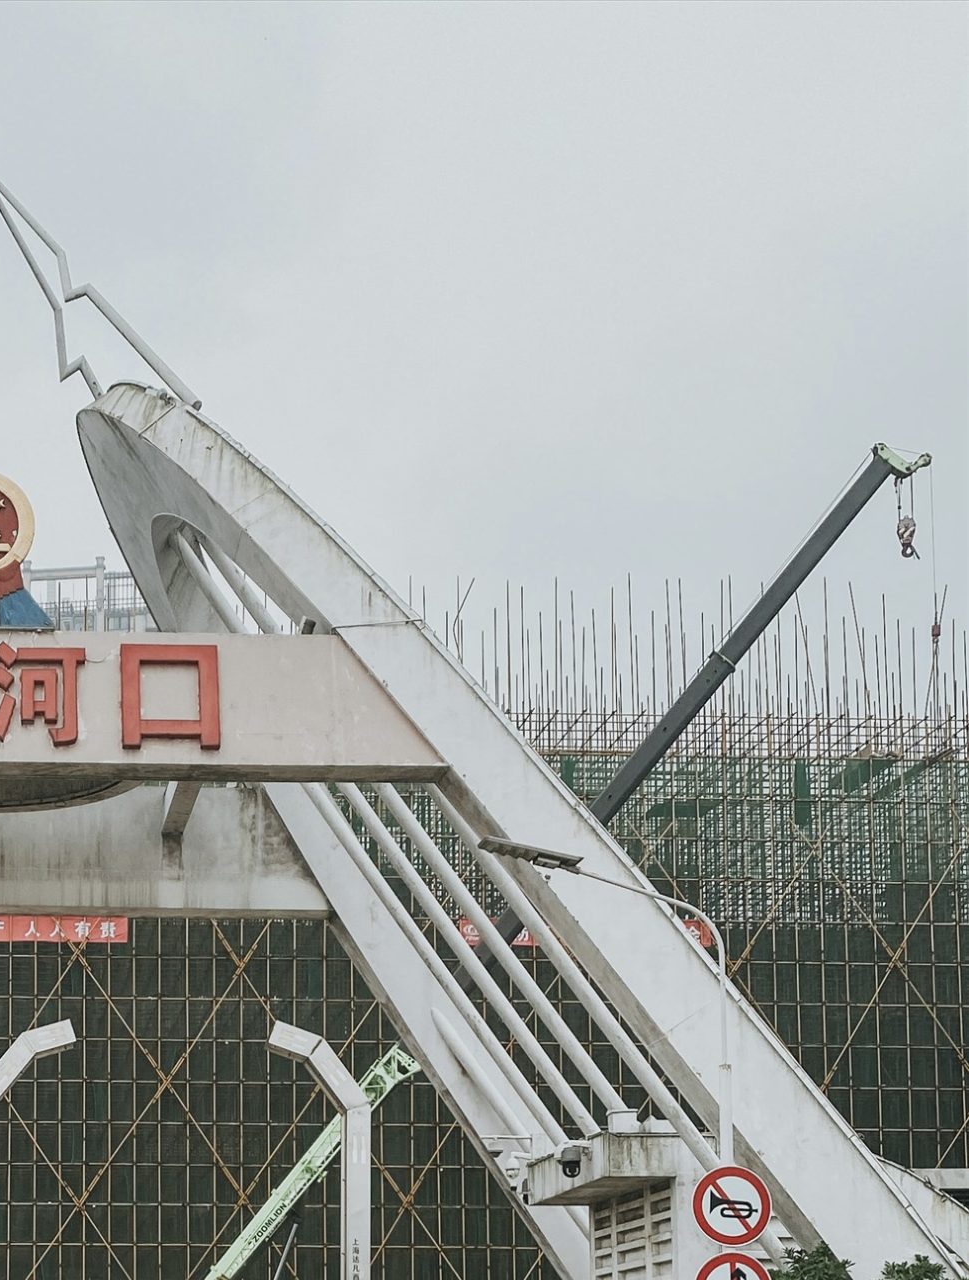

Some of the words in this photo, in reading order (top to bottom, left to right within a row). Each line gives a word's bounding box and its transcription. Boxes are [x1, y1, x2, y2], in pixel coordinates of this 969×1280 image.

[25, 918, 118, 938] 人人有责
[252, 1203, 287, 1243] ZOOMLION
